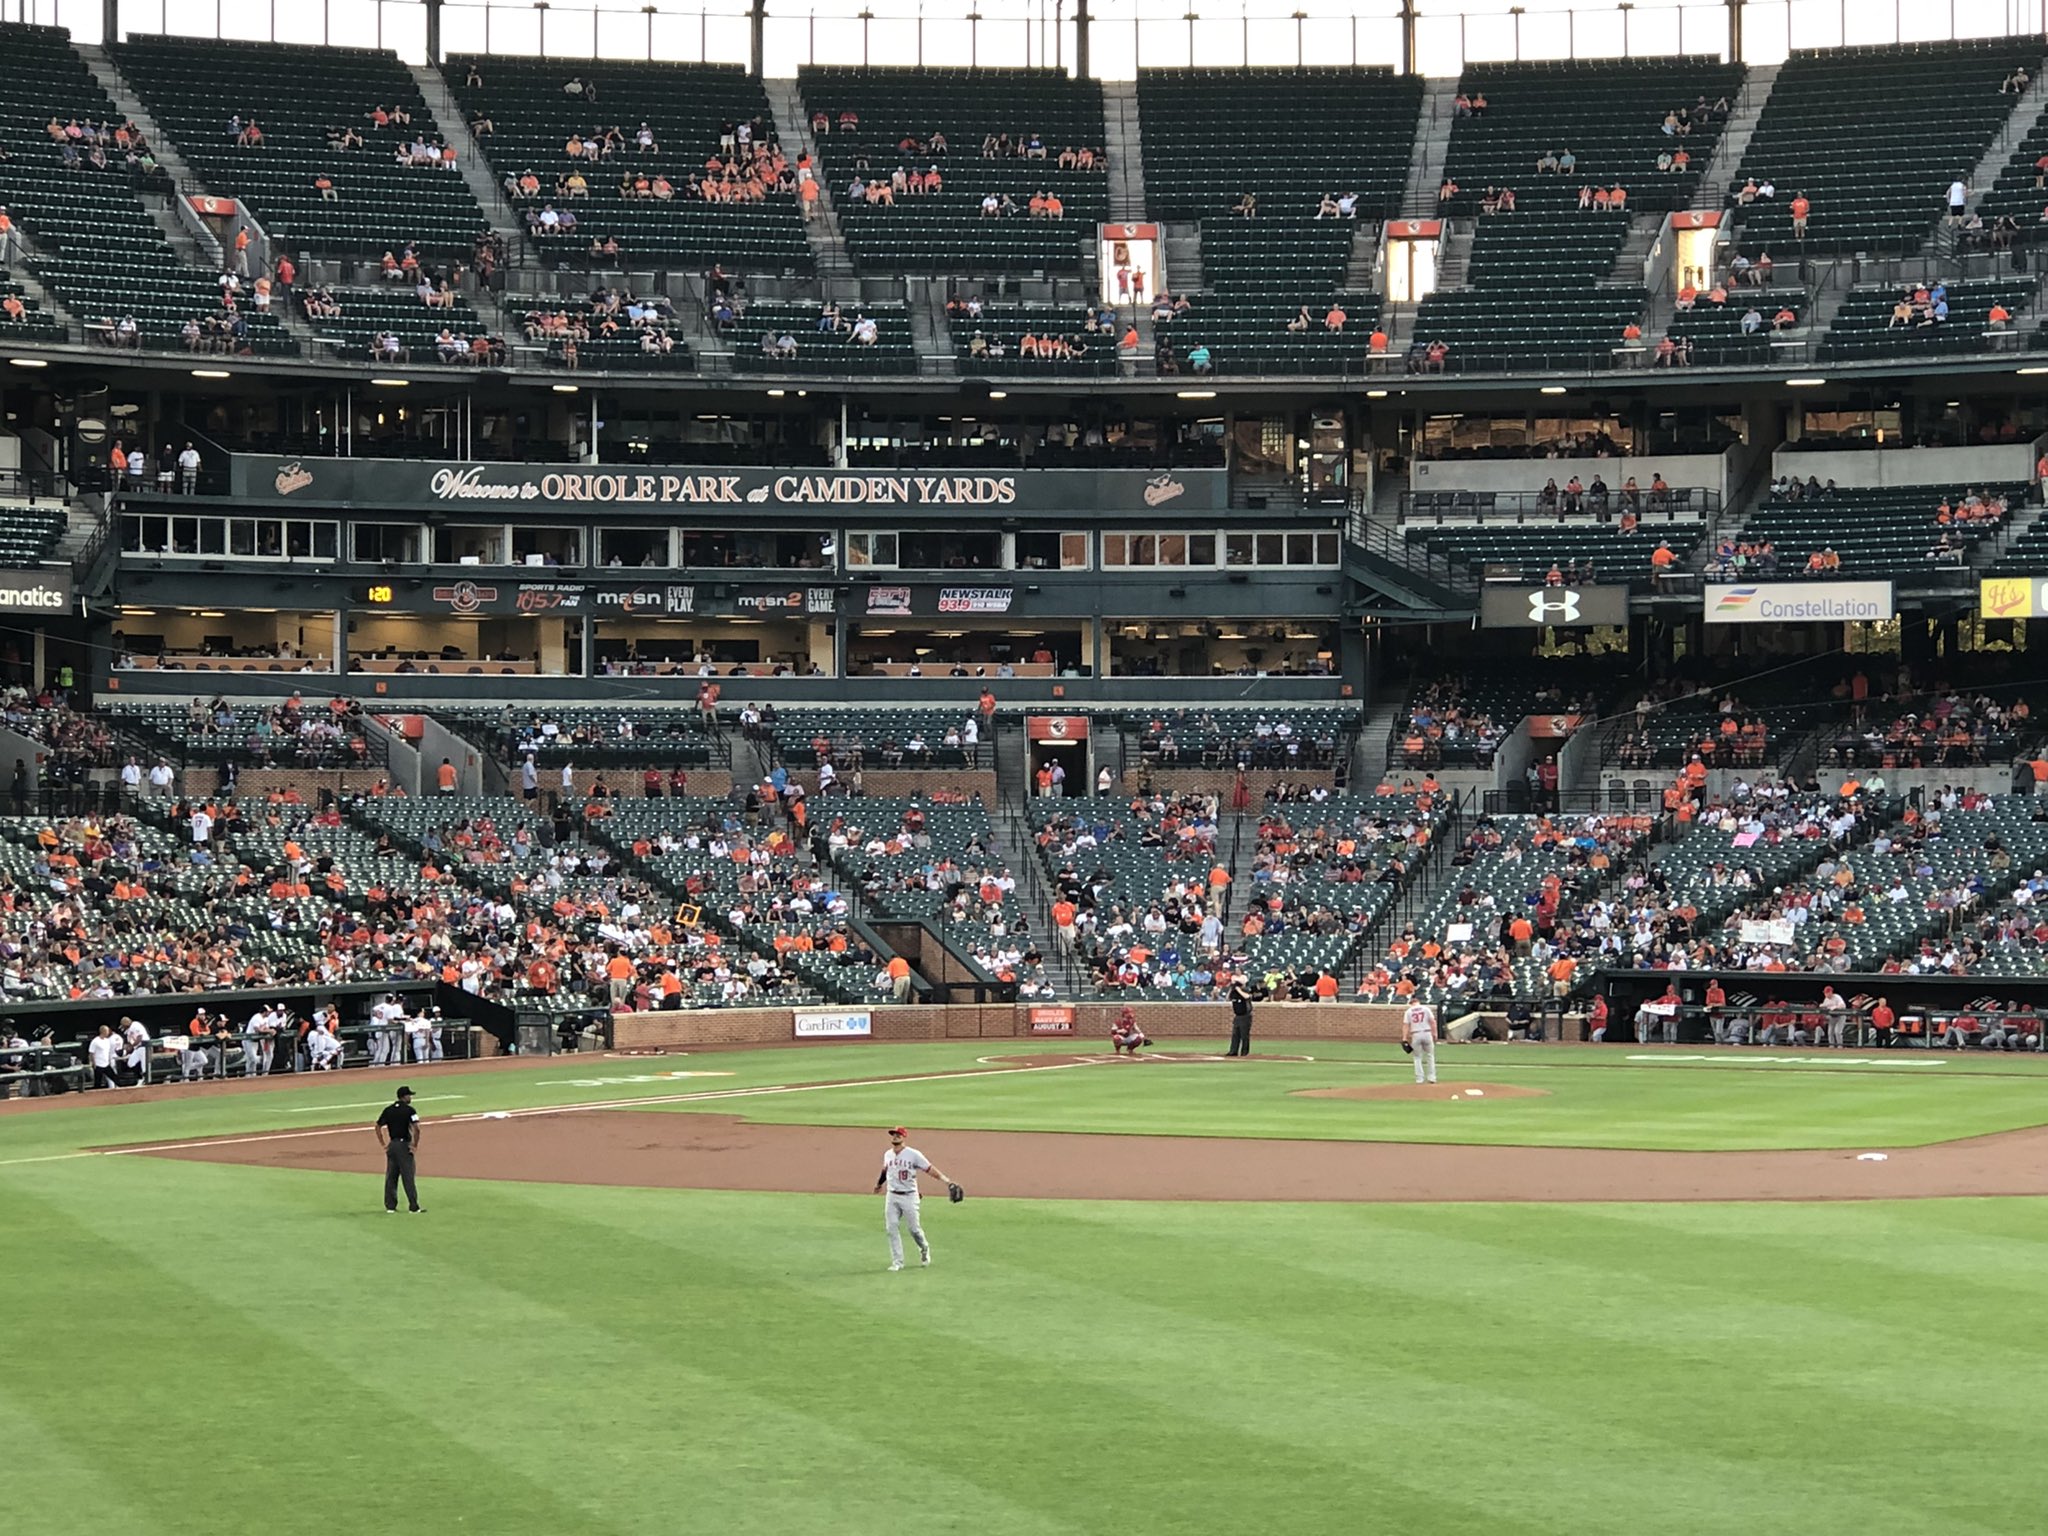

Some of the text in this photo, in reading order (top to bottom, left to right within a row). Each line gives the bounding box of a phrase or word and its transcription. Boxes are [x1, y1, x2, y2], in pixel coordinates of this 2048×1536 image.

[431, 466, 1016, 504] Welcome to ORIOLE PARK at CAMDEN YARDS
[597, 590, 661, 608] masn
[668, 586, 694, 599] EVERY
[738, 591, 802, 607] masn2
[808, 588, 835, 600] EVERY
[941, 589, 1011, 599] NEWSTALK
[668, 598, 694, 612] PLAY.
[808, 600, 836, 612] GAME.
[939, 599, 971, 610] 93.9
[1760, 599, 1878, 617] Constellation
[1411, 1011, 1425, 1024] 37
[798, 1017, 846, 1032] CareFirst
